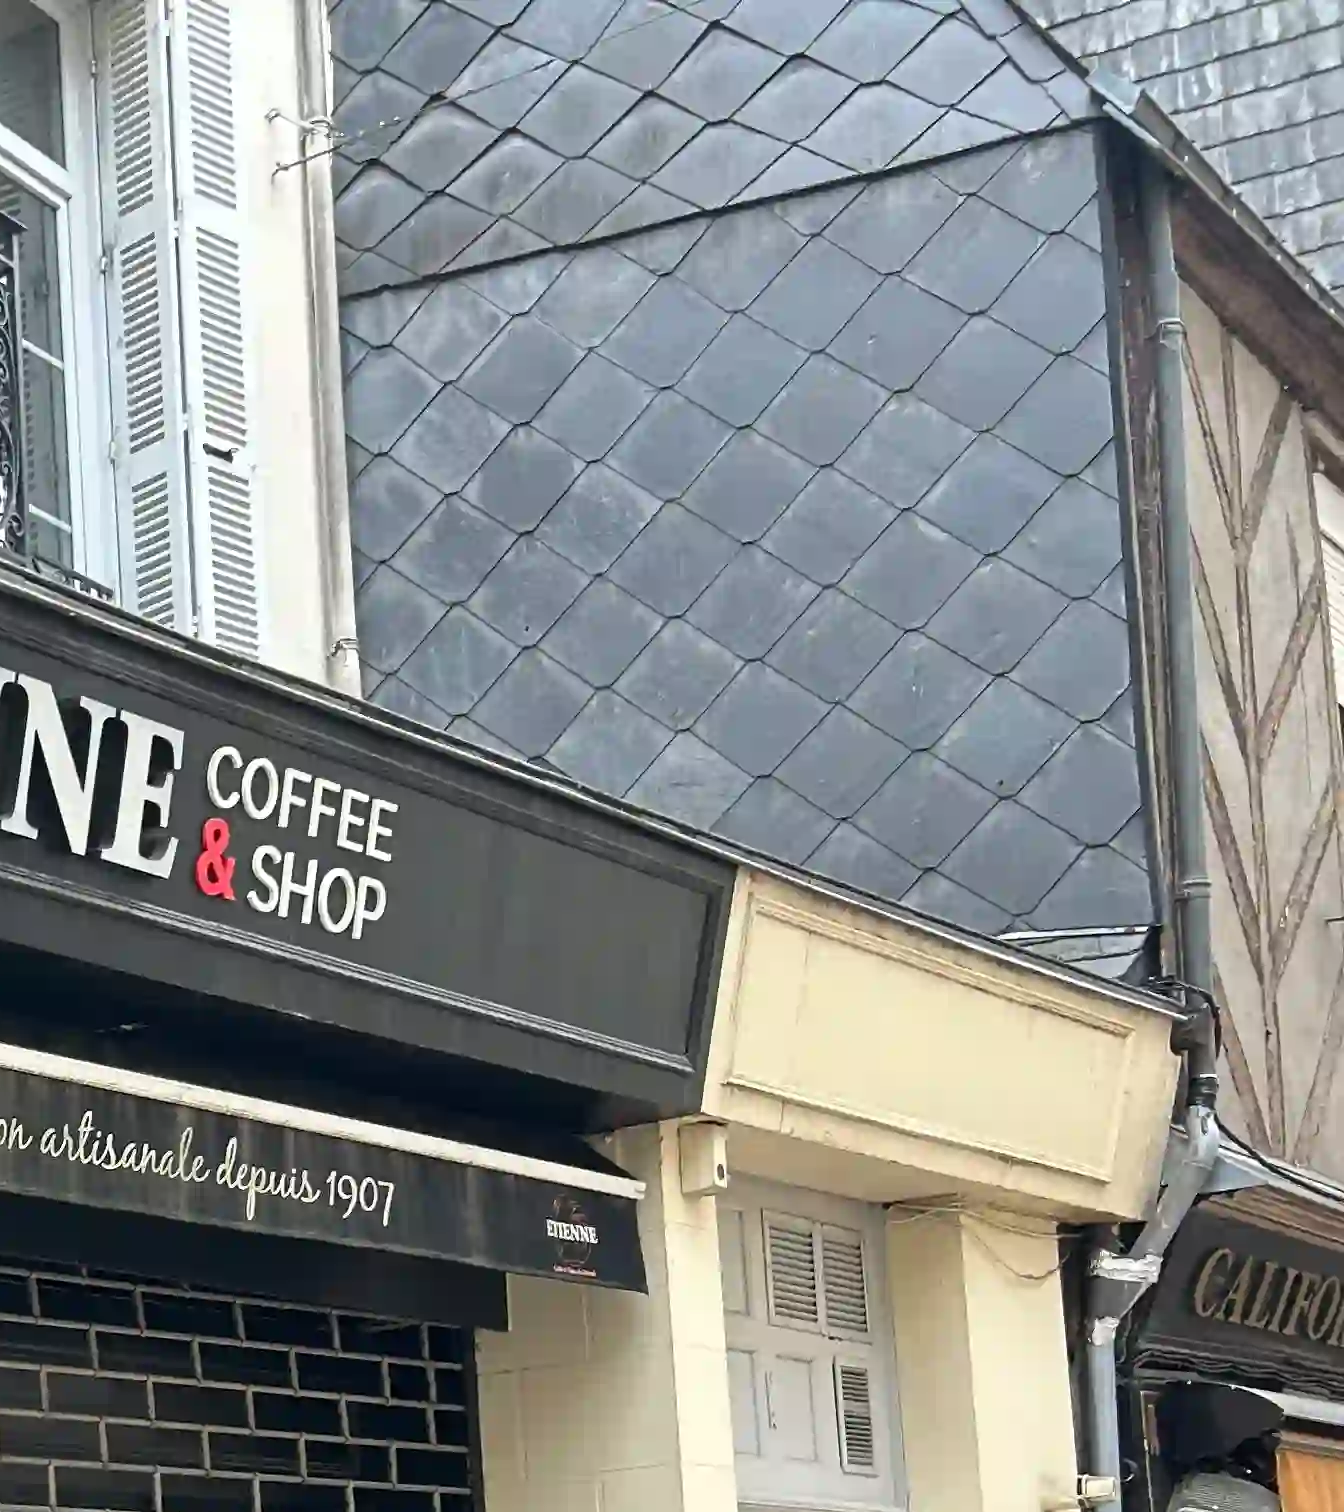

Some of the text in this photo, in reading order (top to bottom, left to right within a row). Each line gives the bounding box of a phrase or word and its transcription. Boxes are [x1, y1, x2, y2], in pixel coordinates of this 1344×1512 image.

[206, 745, 399, 863] COFFEE
[195, 817, 388, 941] & SHOP
[40, 1110, 211, 1183] artisanale
[216, 1137, 321, 1220] depuis
[327, 1170, 395, 1227] 1907
[546, 1219, 599, 1244] ETIENNE
